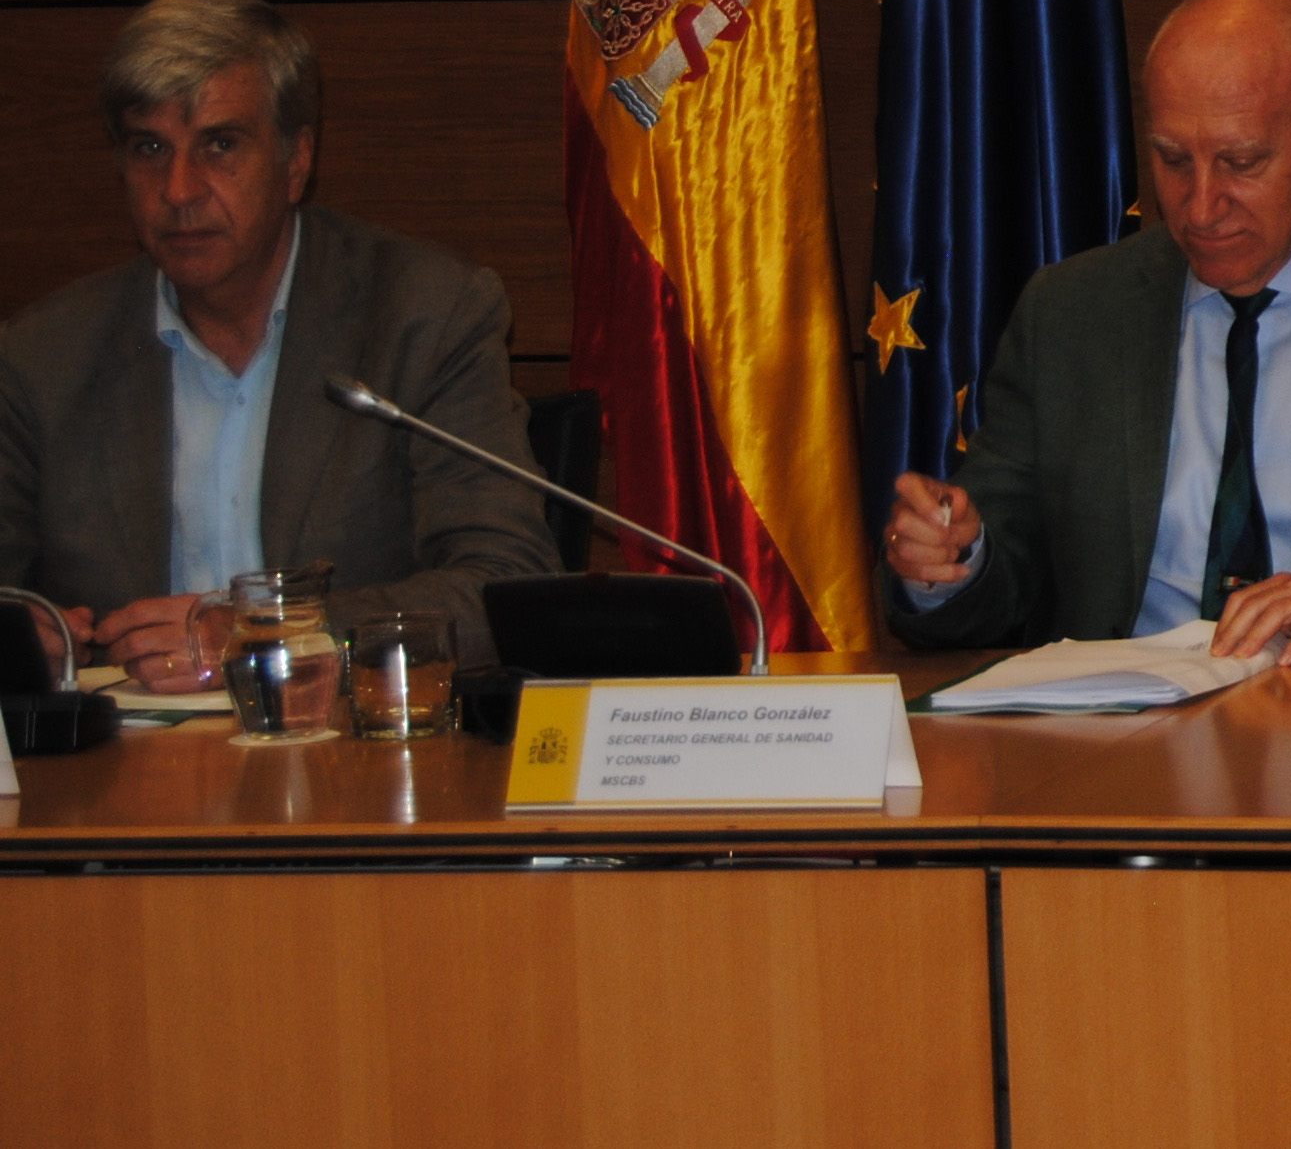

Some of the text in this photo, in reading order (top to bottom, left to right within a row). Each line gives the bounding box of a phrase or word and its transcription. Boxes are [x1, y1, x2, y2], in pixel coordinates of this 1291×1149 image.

[610, 706, 832, 723] Faustino Blanco González
[607, 732, 834, 746] SECRETARIO GENERAL DE SANIDAD
[605, 755, 681, 766] Y CONSUMO
